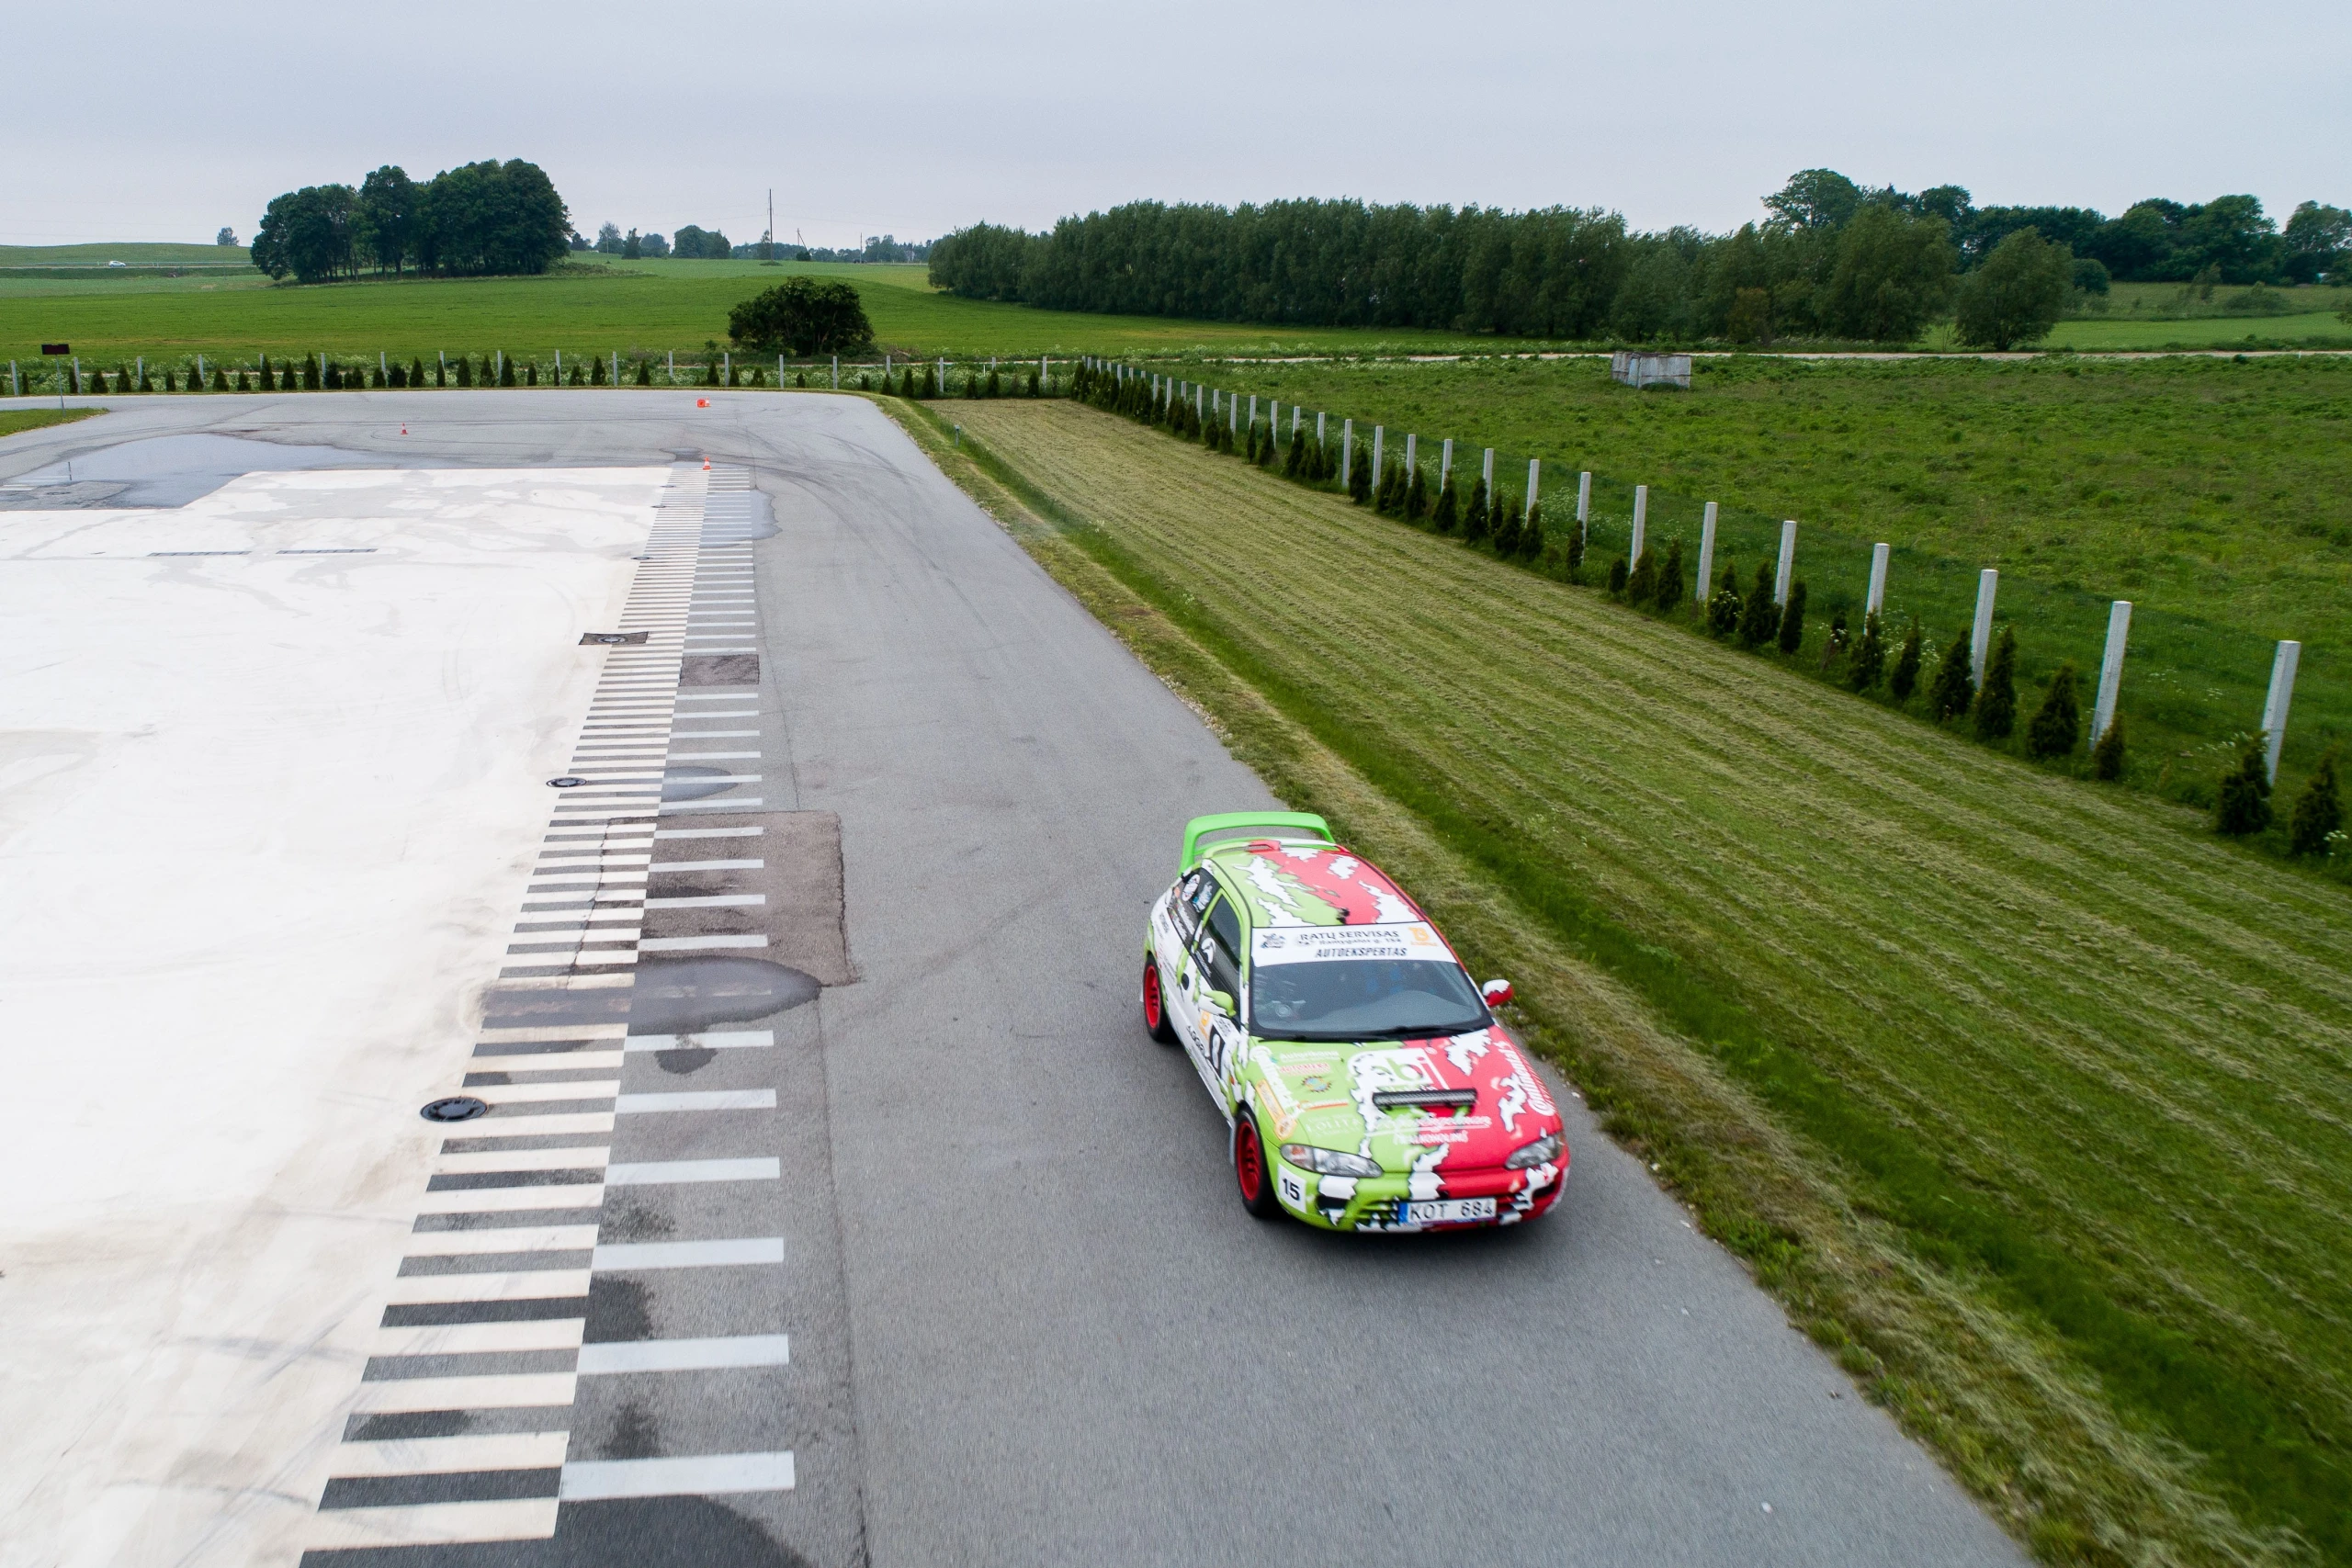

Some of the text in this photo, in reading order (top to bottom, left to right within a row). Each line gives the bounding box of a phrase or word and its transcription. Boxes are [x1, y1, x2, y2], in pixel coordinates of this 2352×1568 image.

[1339, 930, 1400, 940] SERVISAS
[1315, 947, 1408, 959] AUTOEKSPERTAS
[1283, 1178, 1301, 1201] 15
[1410, 1201, 1495, 1220] KOT 684
